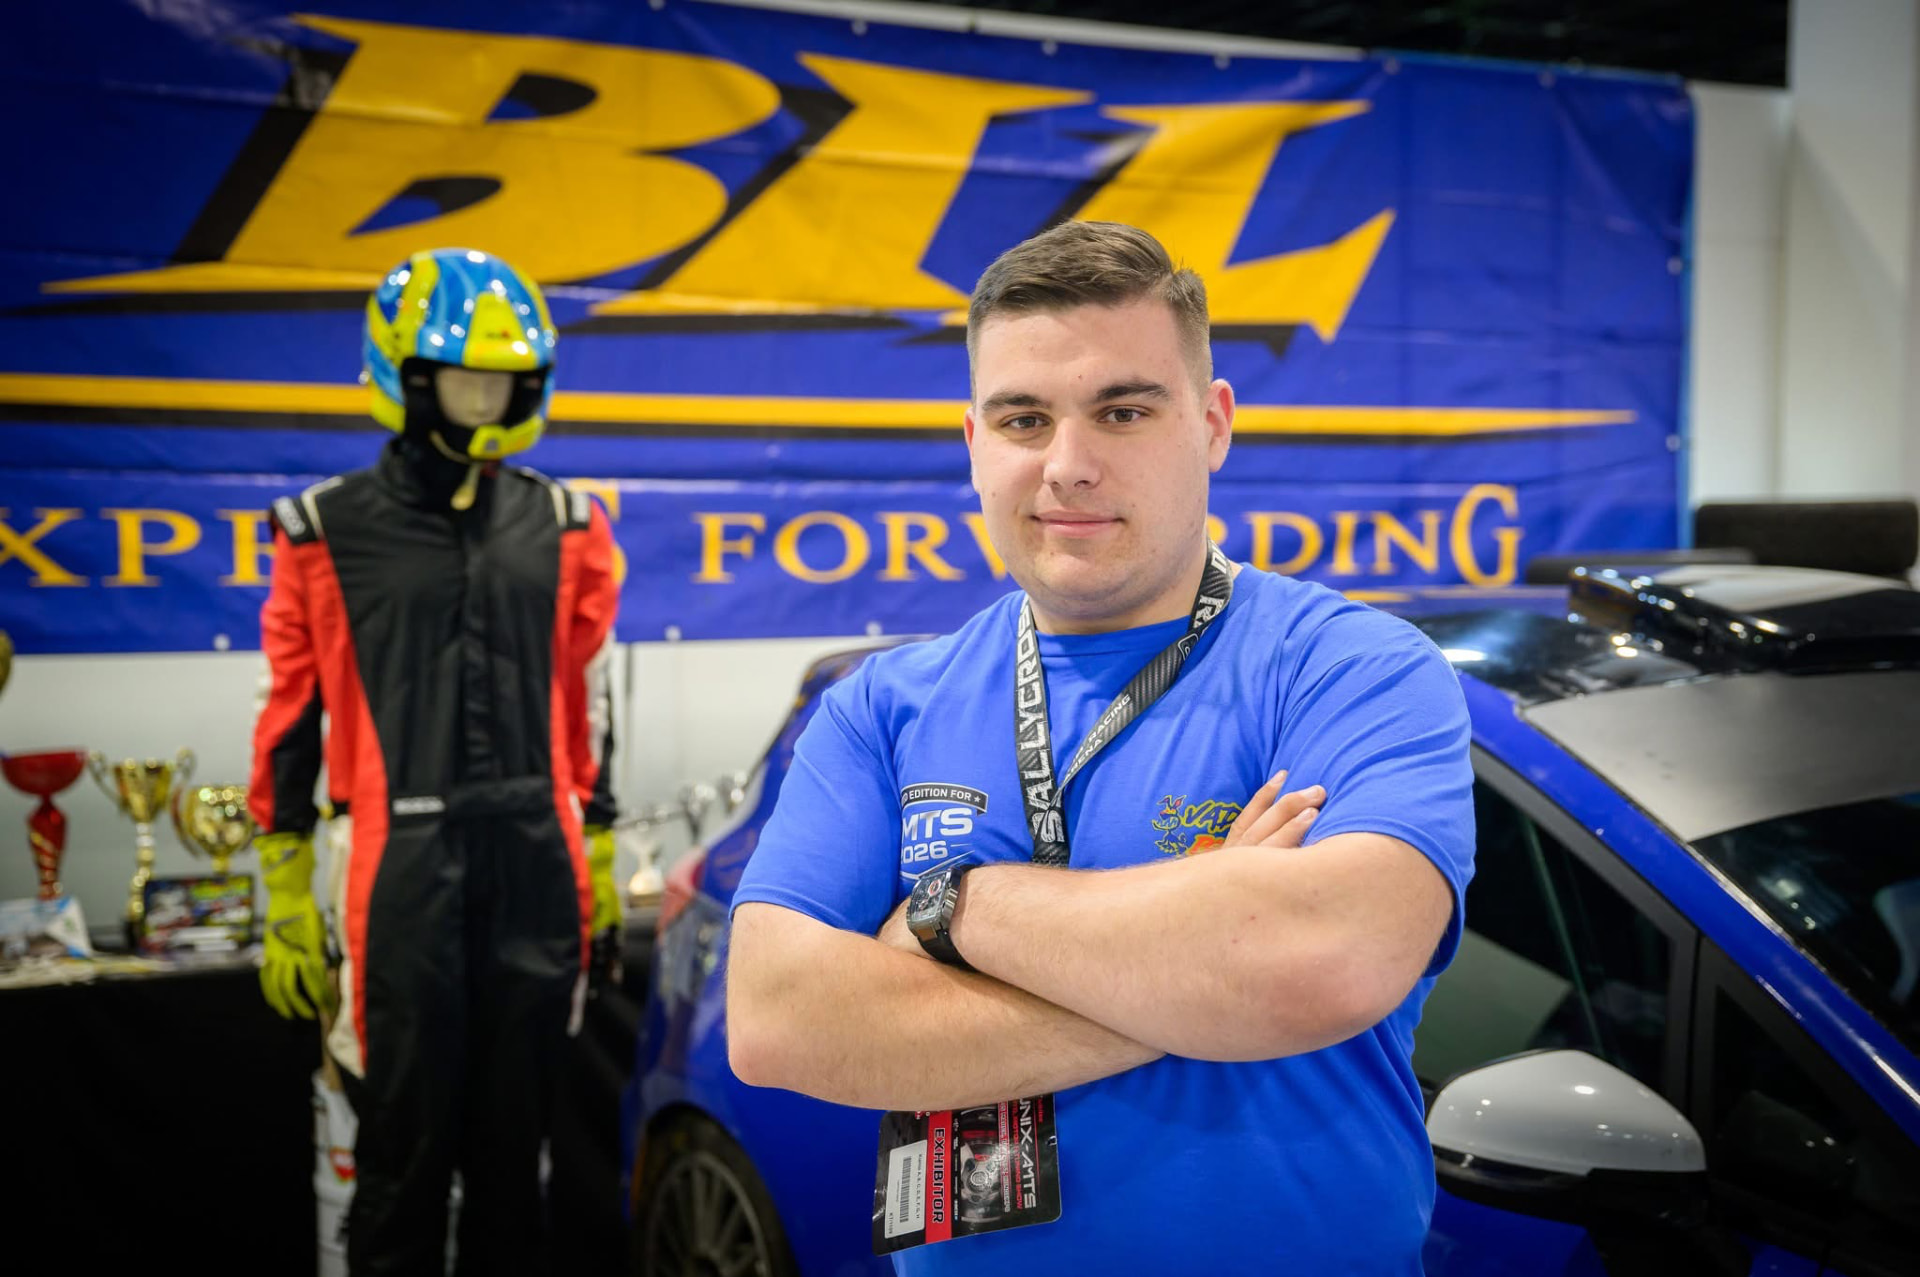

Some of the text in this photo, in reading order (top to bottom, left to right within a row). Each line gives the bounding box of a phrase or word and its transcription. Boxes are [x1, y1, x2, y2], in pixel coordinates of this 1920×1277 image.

[40, 13, 1397, 343] BIL
[690, 483, 1524, 587] FORDING
[1088, 693, 1131, 743] RACING
[908, 787, 948, 800] EDITION
[950, 790, 972, 801] FOR
[902, 807, 973, 841] MTS
[901, 840, 948, 865] 026
[932, 1128, 946, 1224] EXHIBITOR
